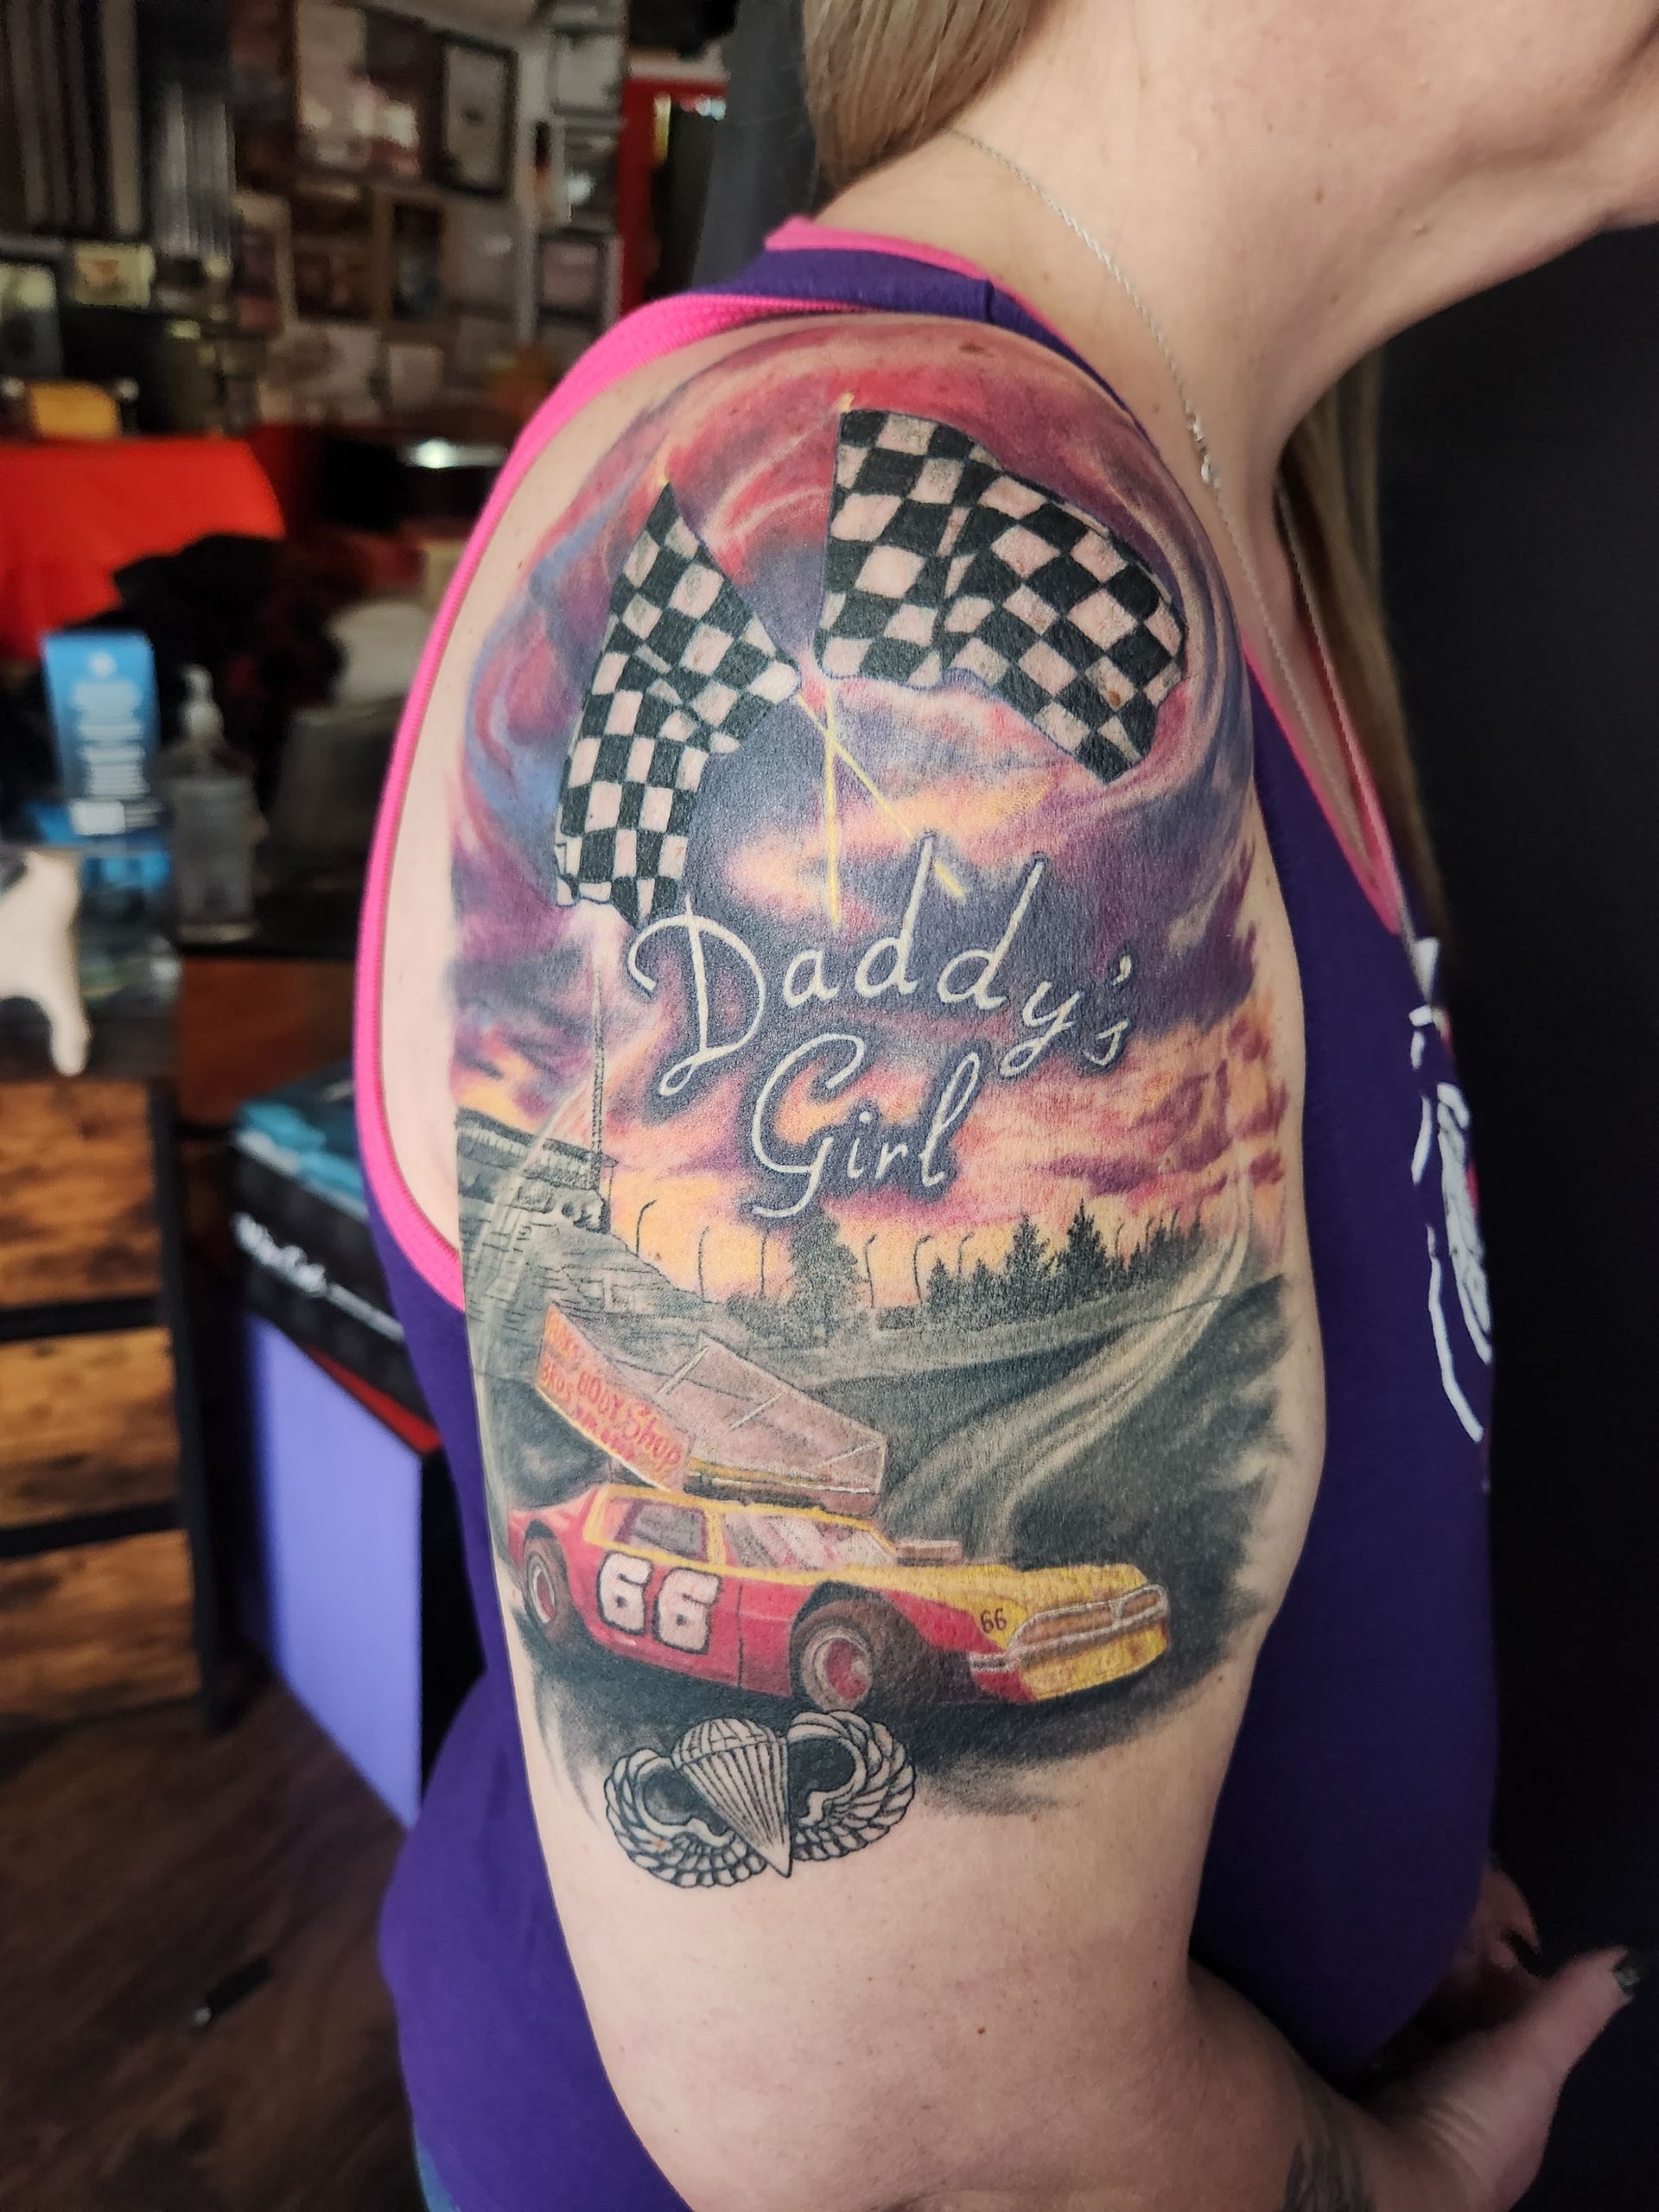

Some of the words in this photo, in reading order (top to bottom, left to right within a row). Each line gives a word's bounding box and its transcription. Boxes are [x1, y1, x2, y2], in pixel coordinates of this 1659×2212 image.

[628, 834, 1132, 1096] Daddy's
[751, 1033, 981, 1218] Girl
[597, 1550, 721, 1655] 66
[980, 1608, 1007, 1634] 66
